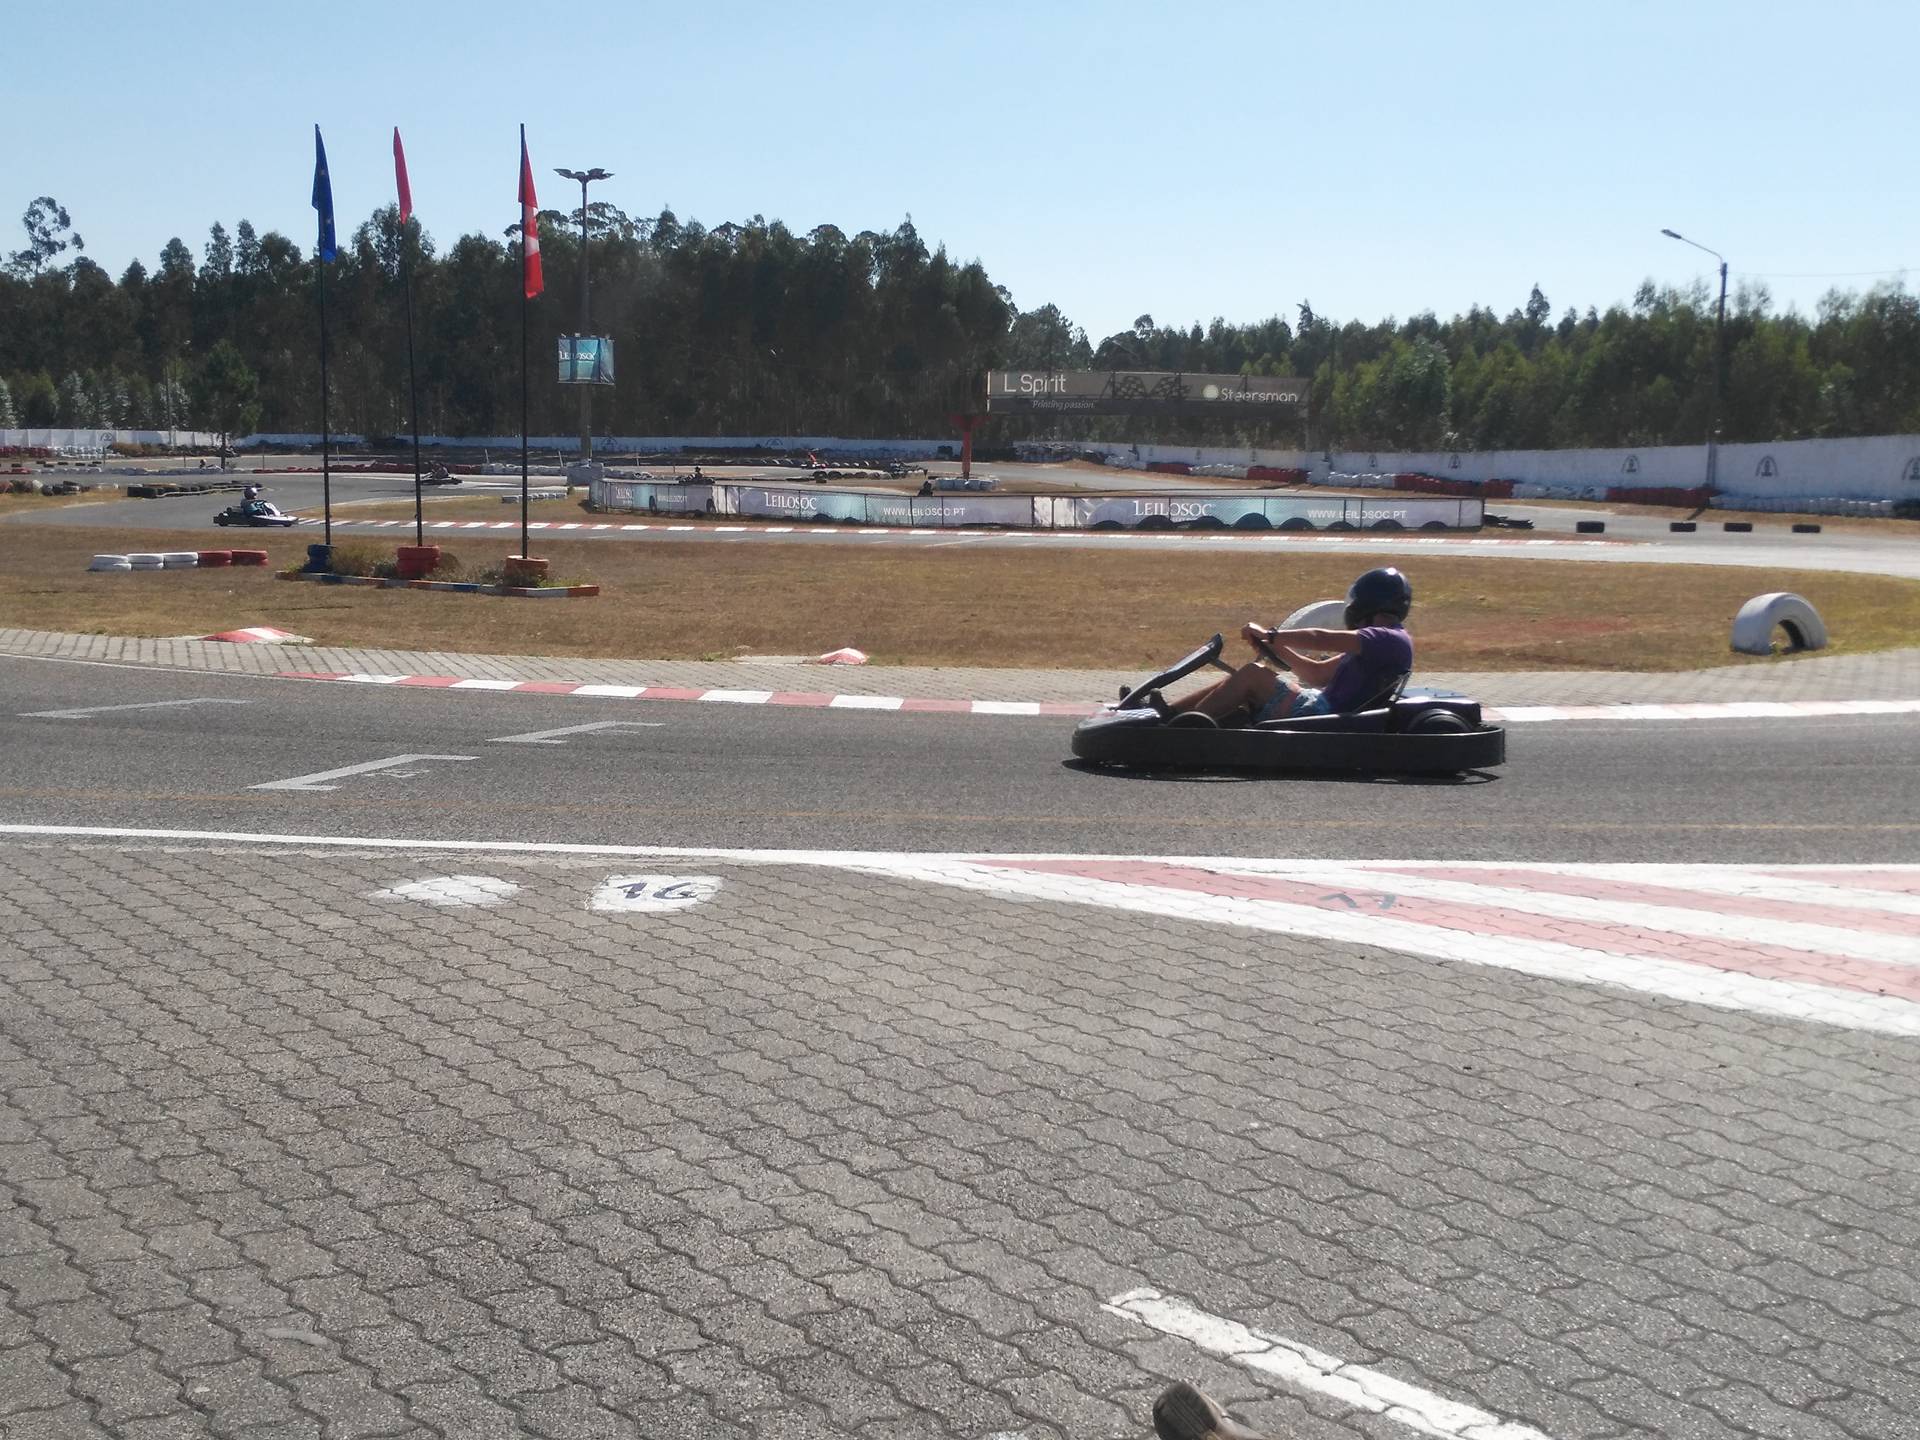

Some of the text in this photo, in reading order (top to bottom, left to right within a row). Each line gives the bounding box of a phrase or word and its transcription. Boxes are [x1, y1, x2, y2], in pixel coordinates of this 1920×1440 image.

[1004, 373, 1067, 397] L Spirit
[764, 492, 817, 510] LEILOSOC
[1133, 500, 1213, 516] LEILOSOC
